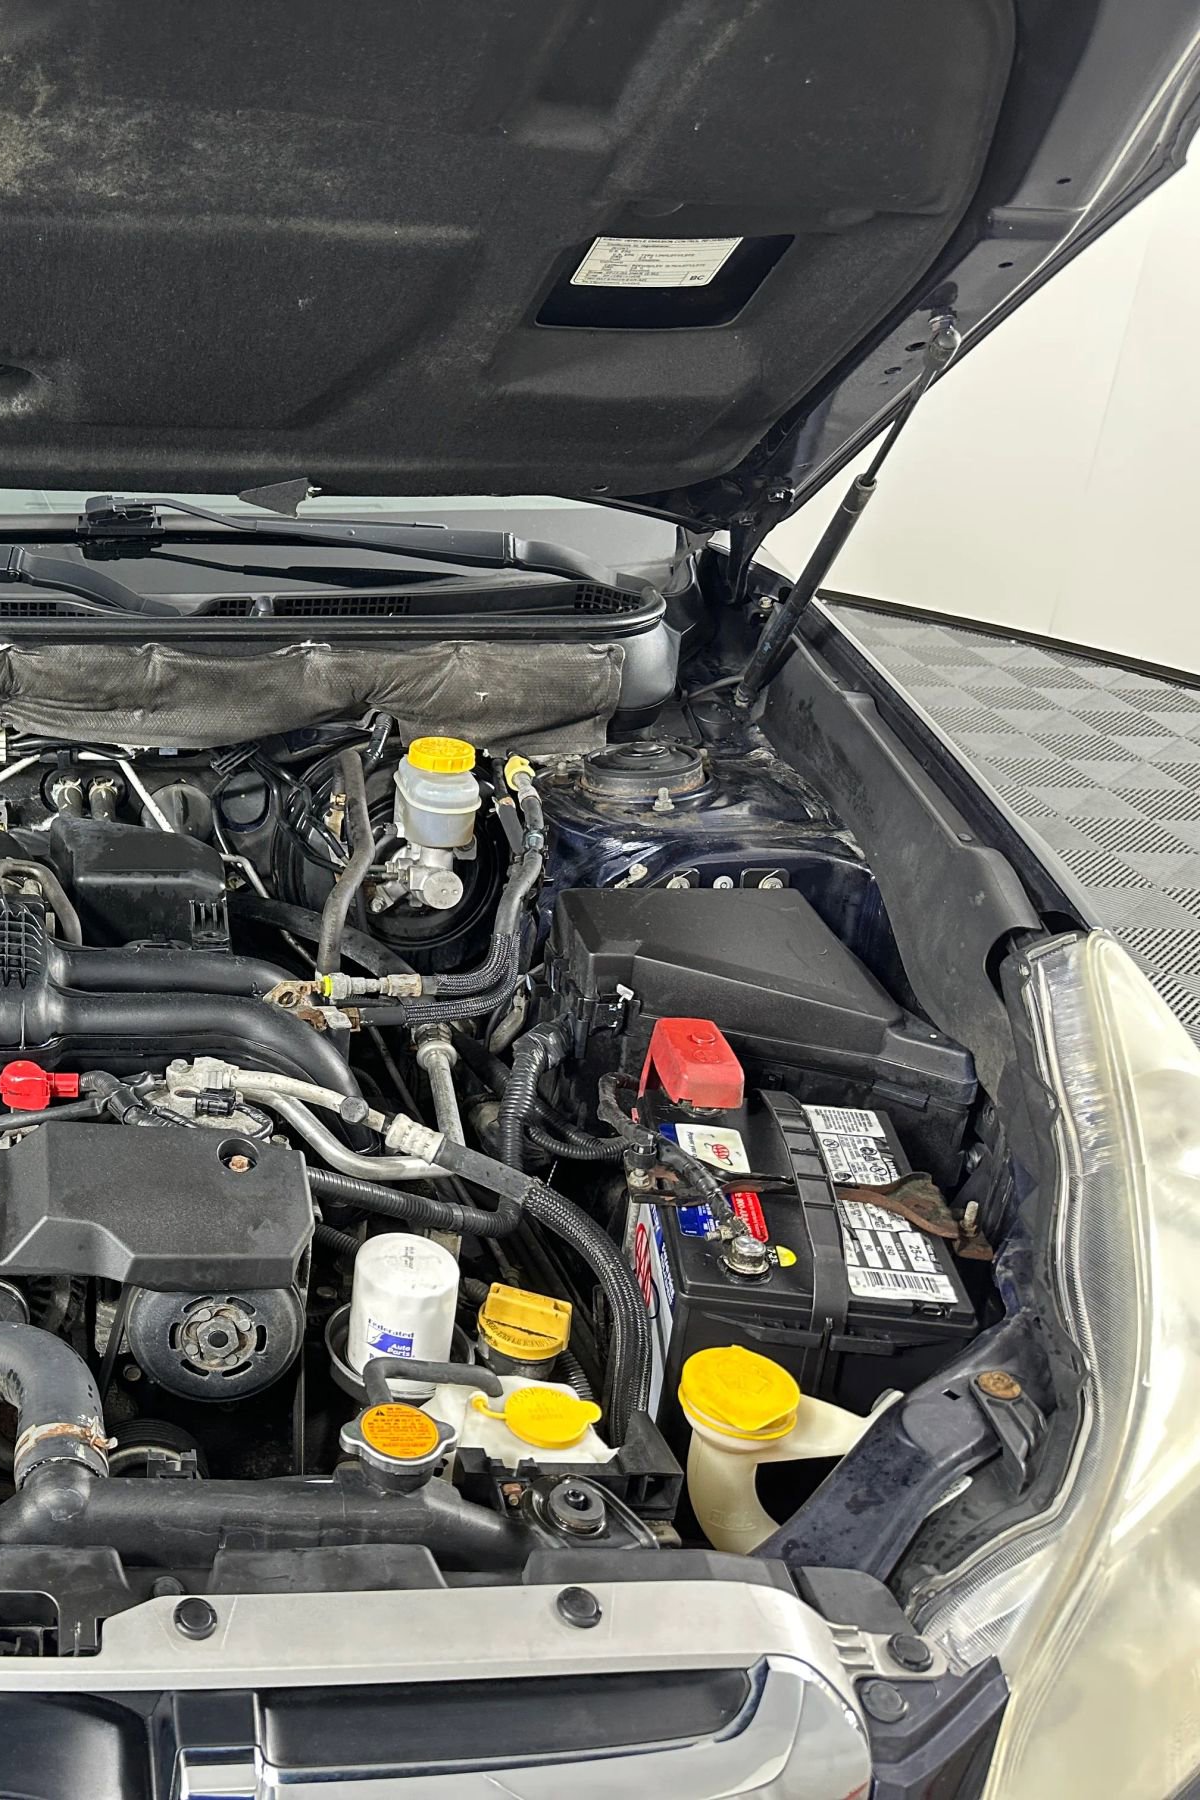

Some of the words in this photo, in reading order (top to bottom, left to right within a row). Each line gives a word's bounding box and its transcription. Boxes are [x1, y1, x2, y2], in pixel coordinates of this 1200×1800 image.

[908, 1244, 925, 1262] 25-C
[386, 1346, 411, 1357] Parts
[392, 1343, 411, 1351] Auto
